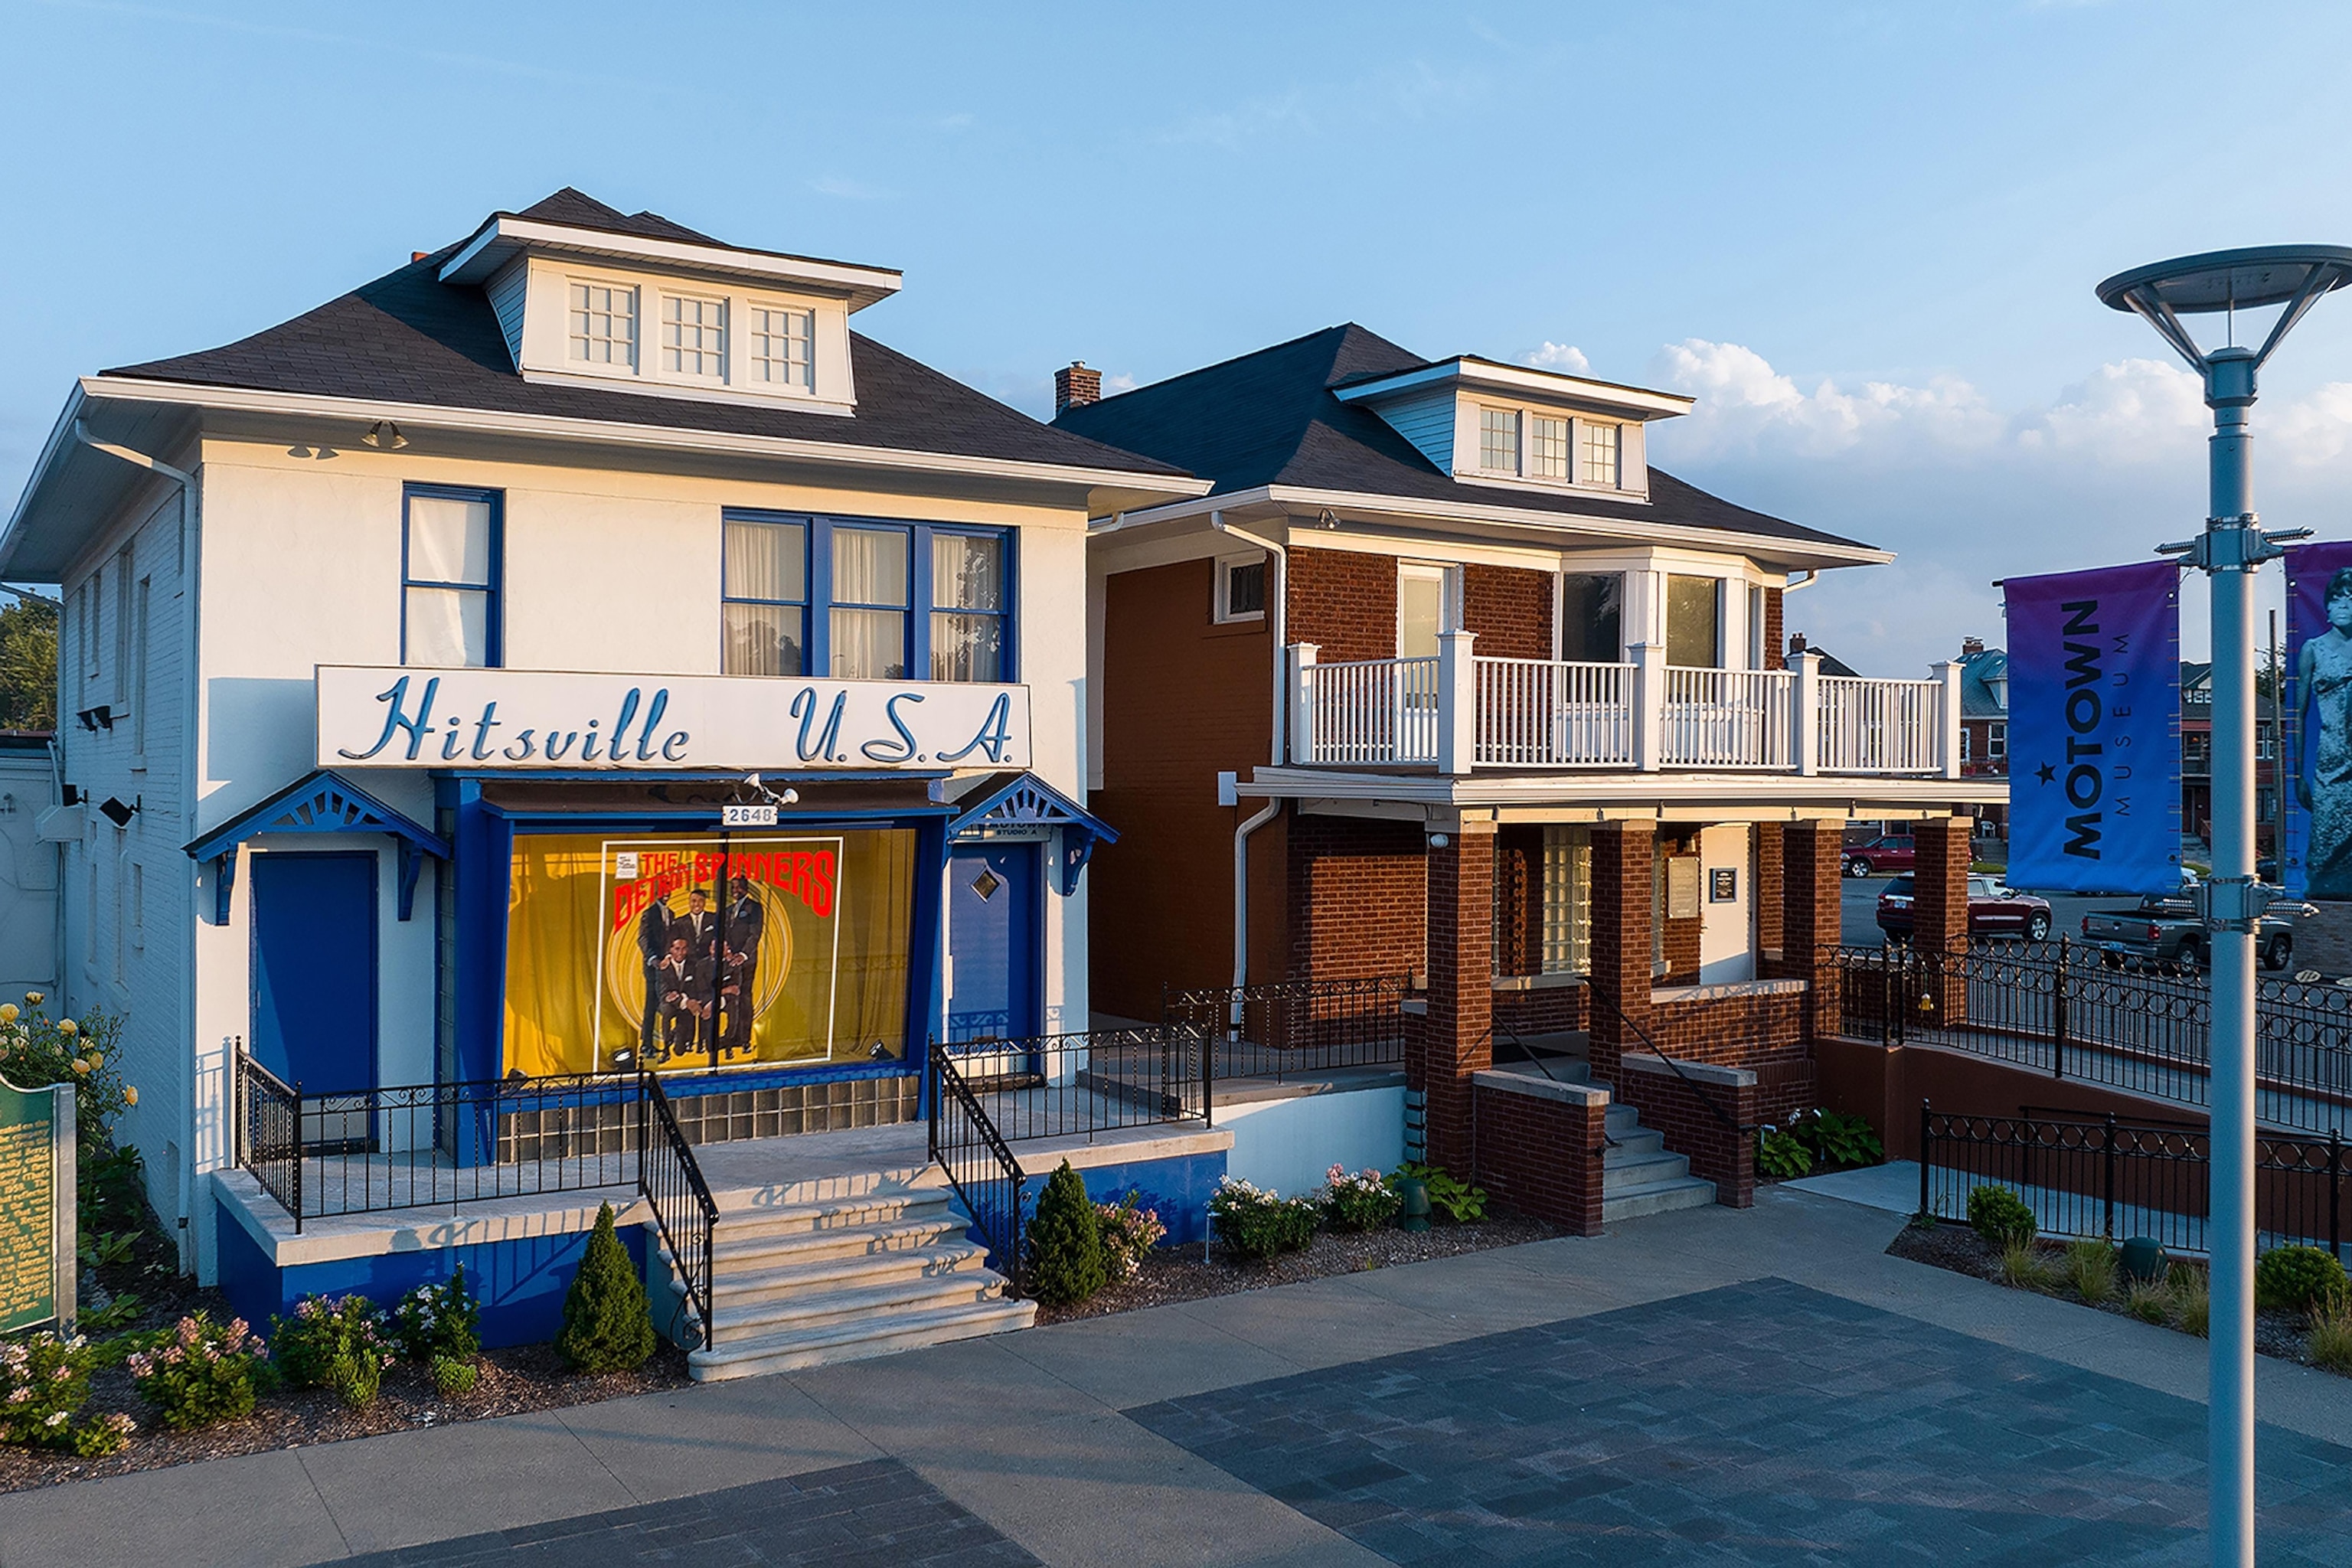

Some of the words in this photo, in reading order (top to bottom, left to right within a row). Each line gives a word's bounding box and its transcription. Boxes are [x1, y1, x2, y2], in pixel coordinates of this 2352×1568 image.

[338, 675, 691, 762] Hitsville
[2061, 599, 2102, 861] MOTOWN
[2112, 632, 2132, 817] MUSEUM
[730, 808, 773, 822] 2648
[613, 863, 691, 936] DETROIT
[694, 850, 835, 918] SPINNERS
[642, 853, 678, 876] THE
